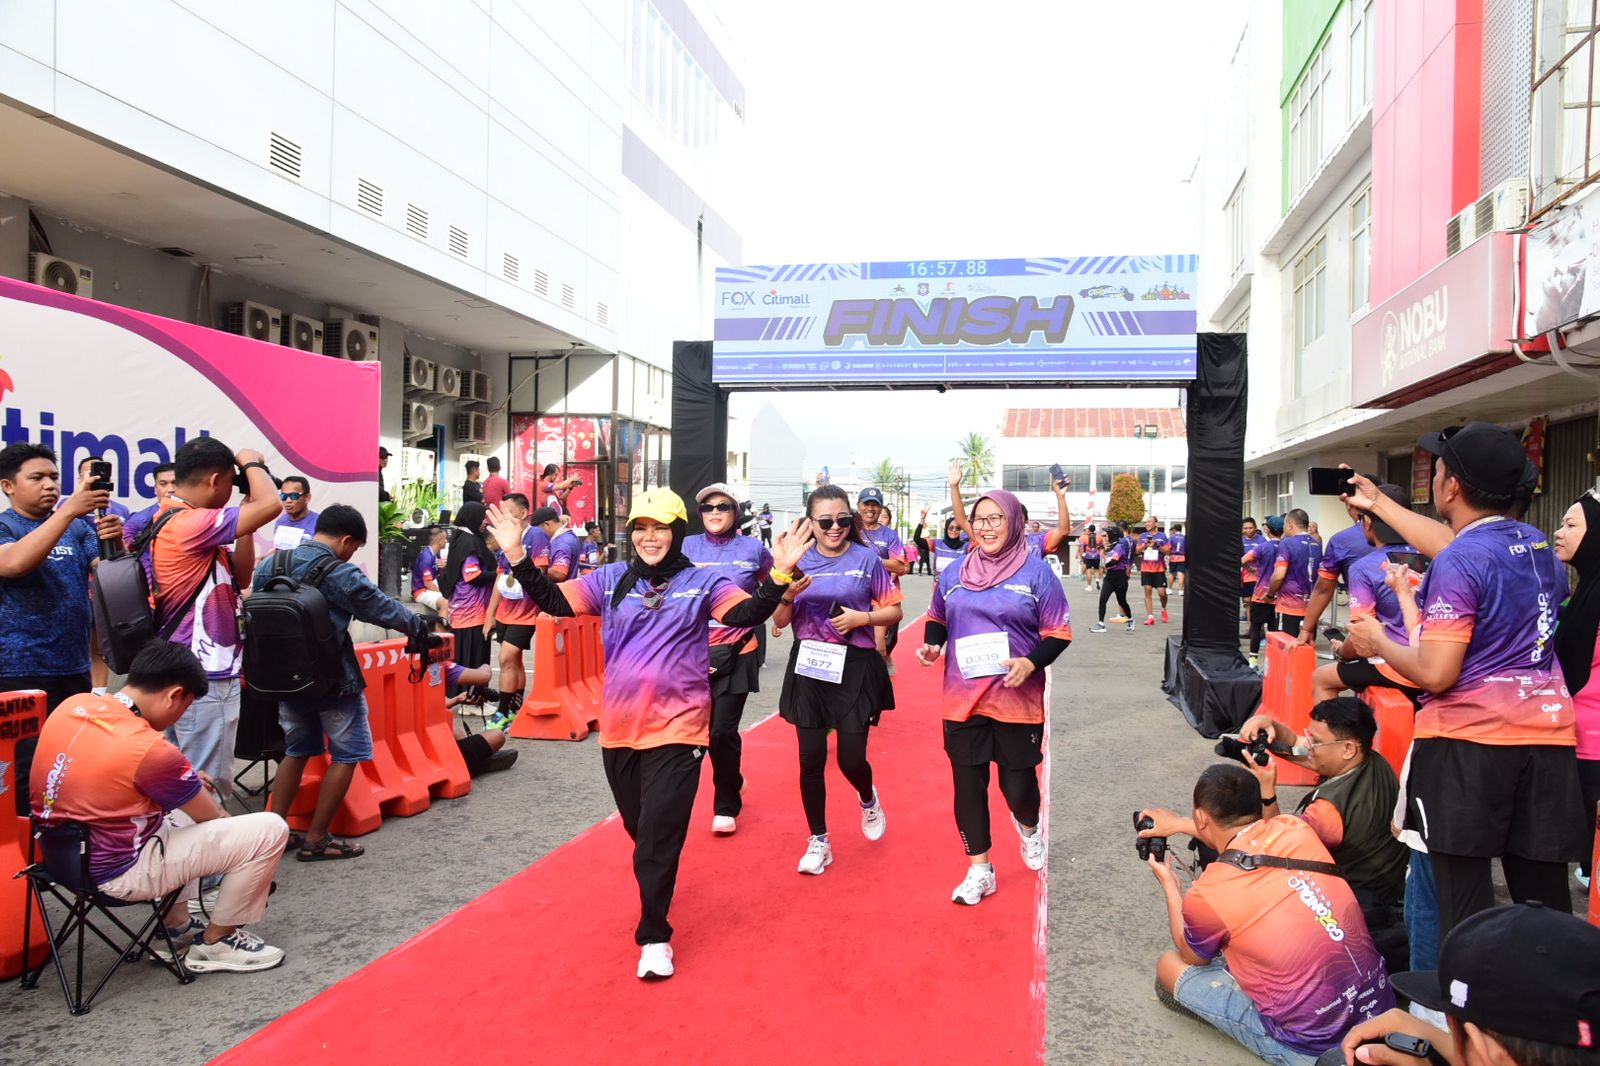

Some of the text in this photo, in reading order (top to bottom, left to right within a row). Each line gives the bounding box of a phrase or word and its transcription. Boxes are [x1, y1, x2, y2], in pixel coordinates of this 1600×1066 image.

[908, 260, 987, 276] 16:57.88
[722, 291, 755, 306] FOX
[762, 293, 811, 305] Citimall
[823, 295, 1075, 346] FINISH
[1399, 285, 1448, 351] NOBU
[806, 657, 833, 669] 1677
[1288, 876, 1345, 942] GORONTALO
